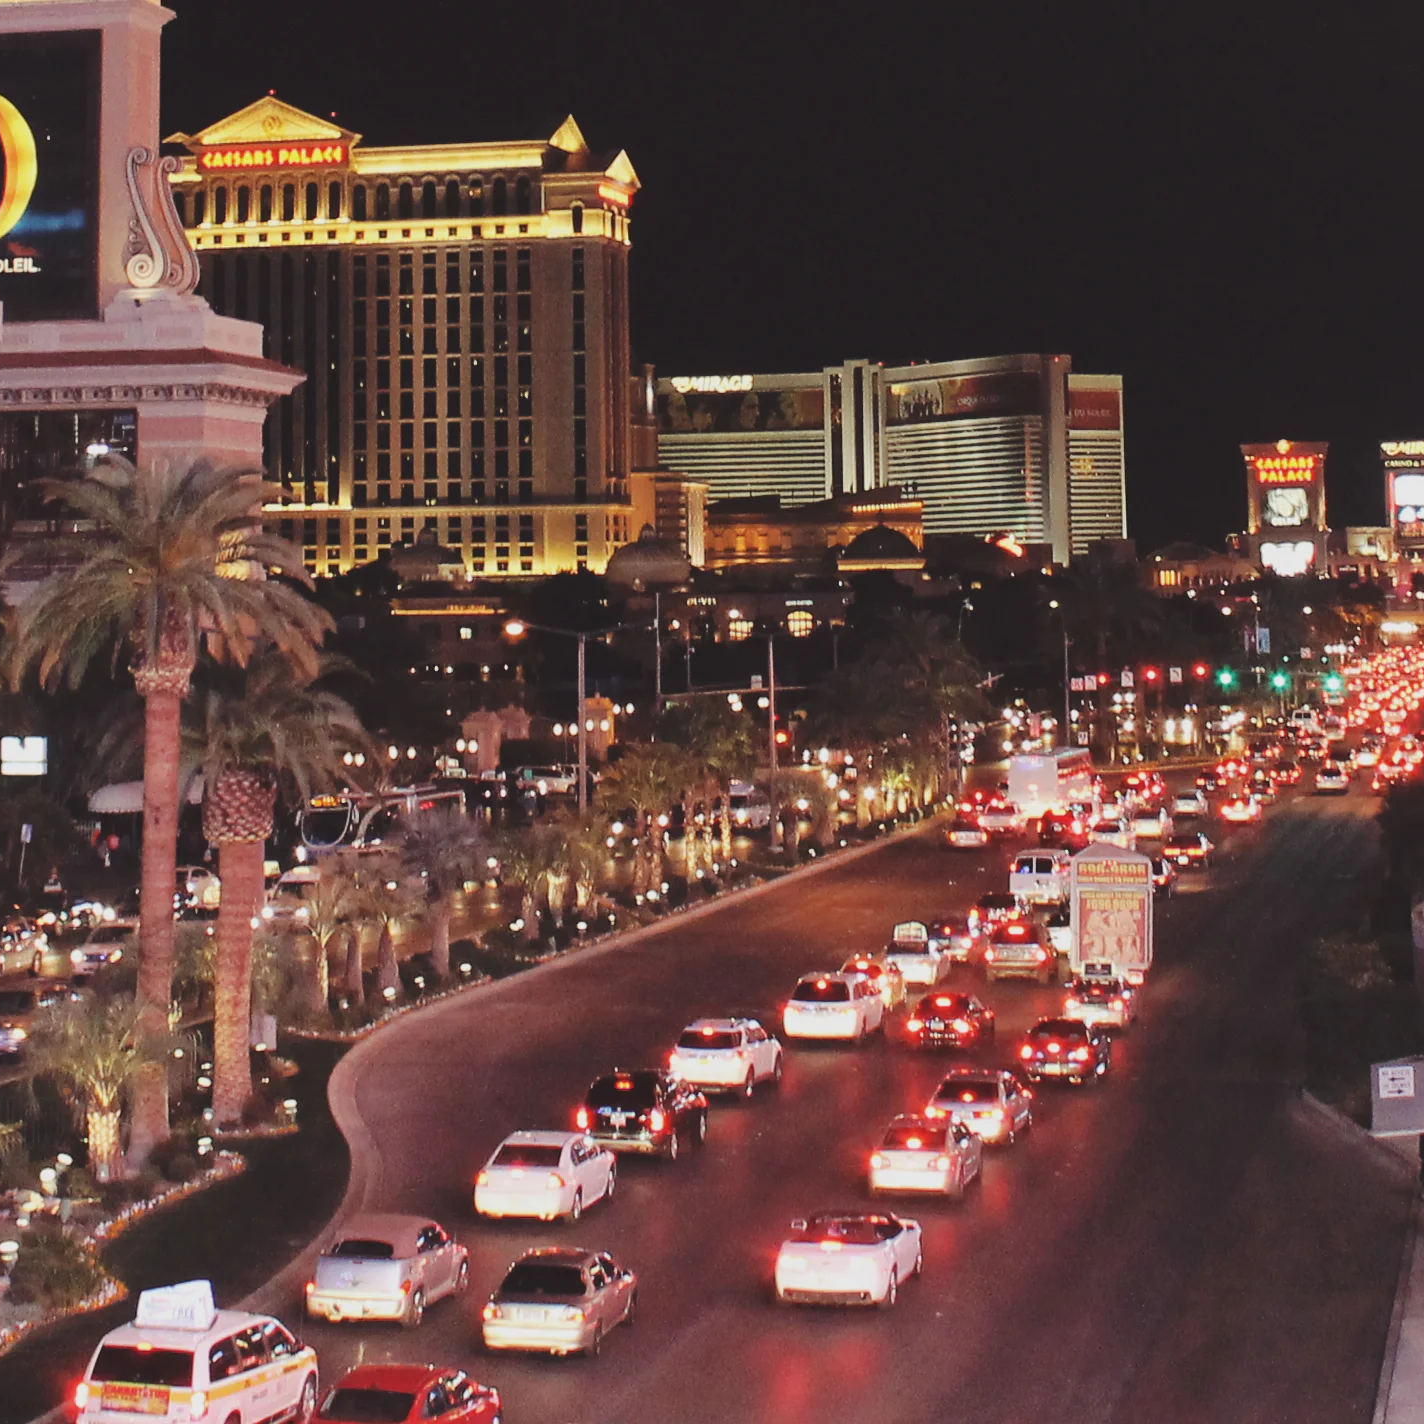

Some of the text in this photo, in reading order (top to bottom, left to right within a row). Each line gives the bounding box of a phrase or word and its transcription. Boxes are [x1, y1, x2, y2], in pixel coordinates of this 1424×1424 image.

[202, 146, 342, 168] CAESARS PALACE
[690, 375, 753, 393] MIRAGE
[1256, 457, 1315, 470] CAESARS
[1259, 470, 1312, 483] PALACE
